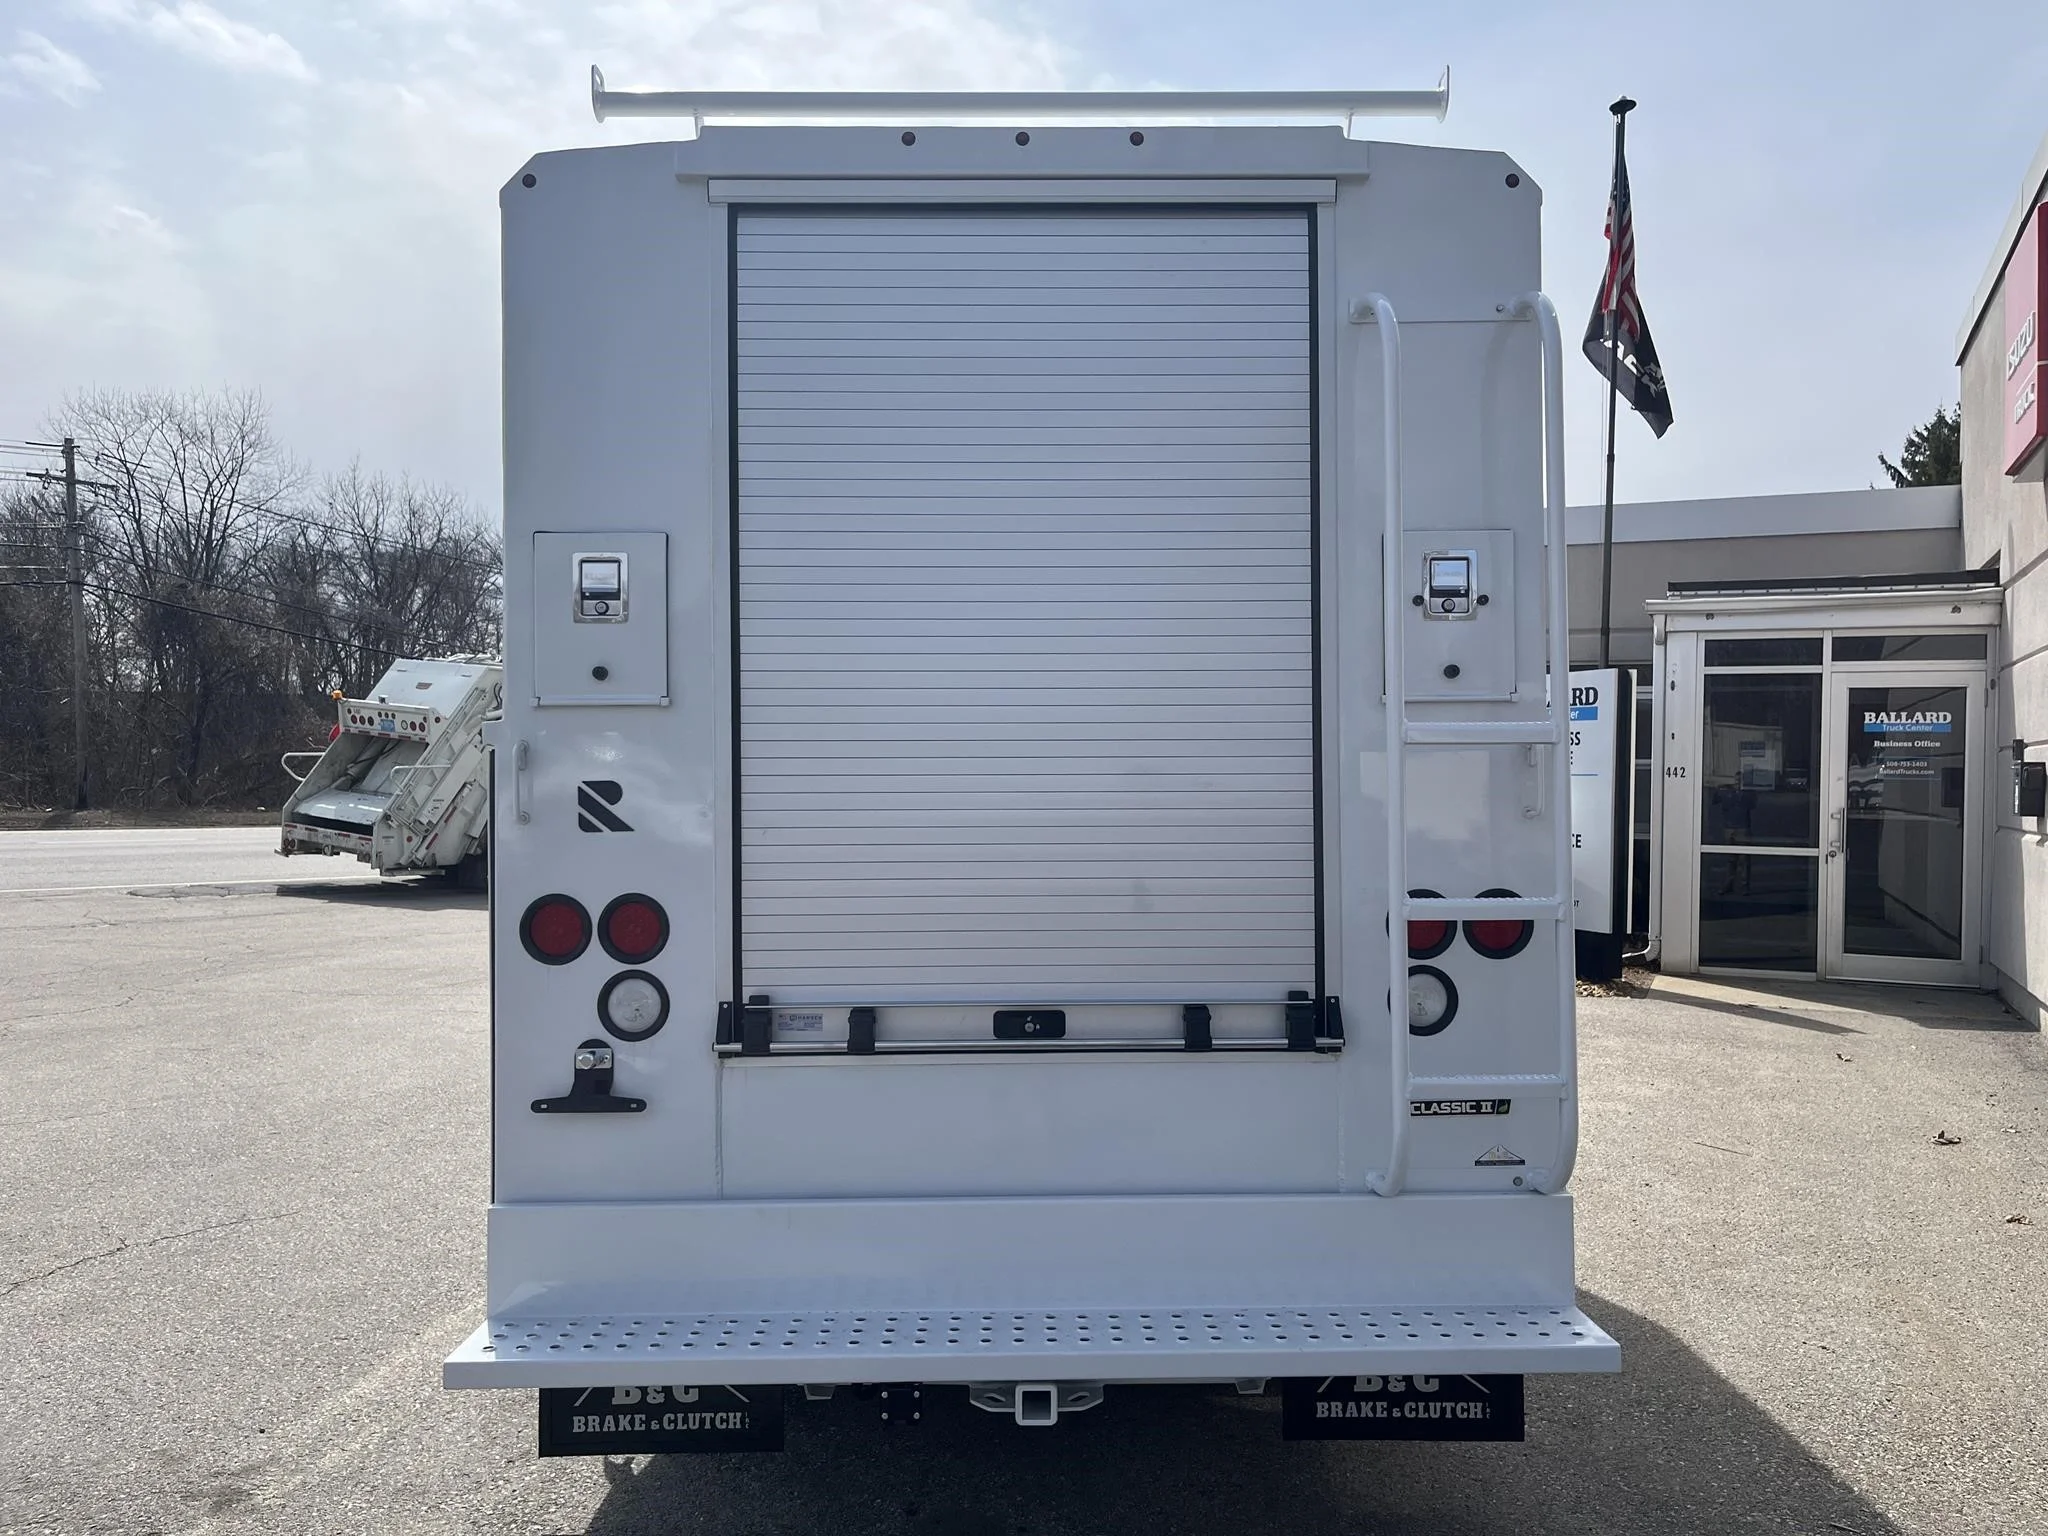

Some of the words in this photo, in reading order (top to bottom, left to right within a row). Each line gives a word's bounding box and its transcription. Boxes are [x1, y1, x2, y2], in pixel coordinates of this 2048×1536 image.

[2006, 311, 2036, 381] ISUZU
[1863, 711, 1952, 724] BALLARD
[1874, 740, 1912, 748] Business
[1914, 740, 1941, 748] Office
[1665, 766, 1686, 778] 442
[1411, 1101, 1477, 1114] CLASSIC
[1480, 1101, 1493, 1112] II
[1316, 1402, 1388, 1418] BRAKE
[1404, 1402, 1483, 1418] CLUTCH
[572, 1414, 646, 1432] BRAKE
[662, 1412, 742, 1431] CLUTCH
